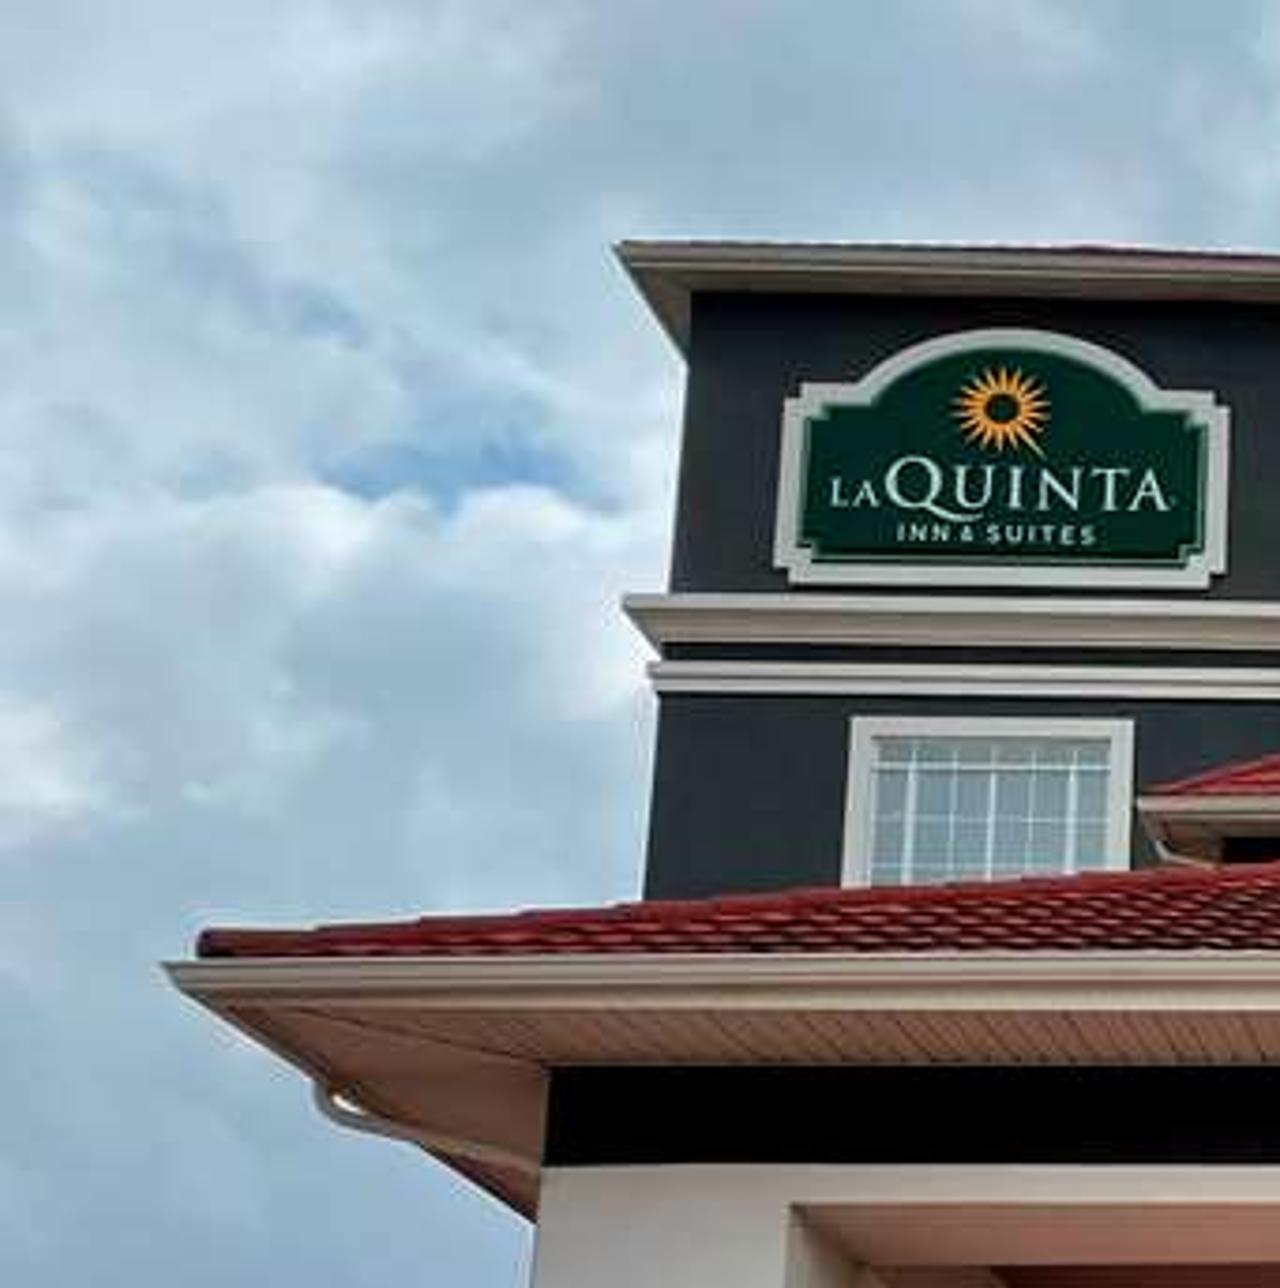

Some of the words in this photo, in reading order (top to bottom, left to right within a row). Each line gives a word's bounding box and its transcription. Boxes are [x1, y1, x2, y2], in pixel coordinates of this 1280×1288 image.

[829, 476, 881, 508] LA
[884, 455, 1171, 523] QUINTA
[897, 522, 951, 542] INN
[959, 524, 975, 542] &
[987, 524, 1098, 545] SUITES
